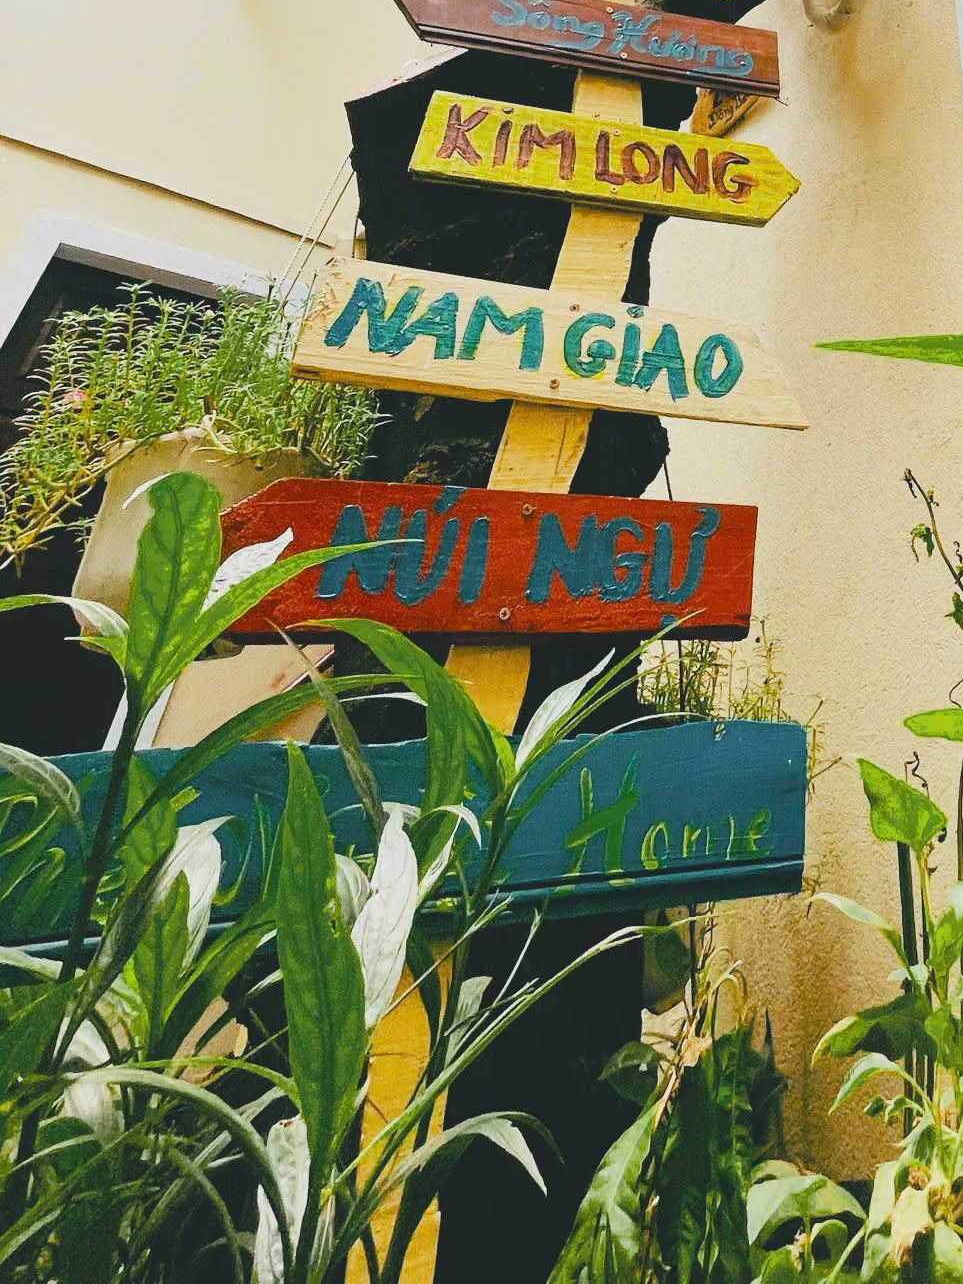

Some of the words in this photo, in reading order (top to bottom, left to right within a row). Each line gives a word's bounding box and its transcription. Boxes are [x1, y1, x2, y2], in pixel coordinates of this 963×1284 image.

[606, 11, 754, 77] Hương
[595, 130, 760, 204] LONG
[323, 277, 544, 372] NAM
[315, 485, 490, 606] NÚI
